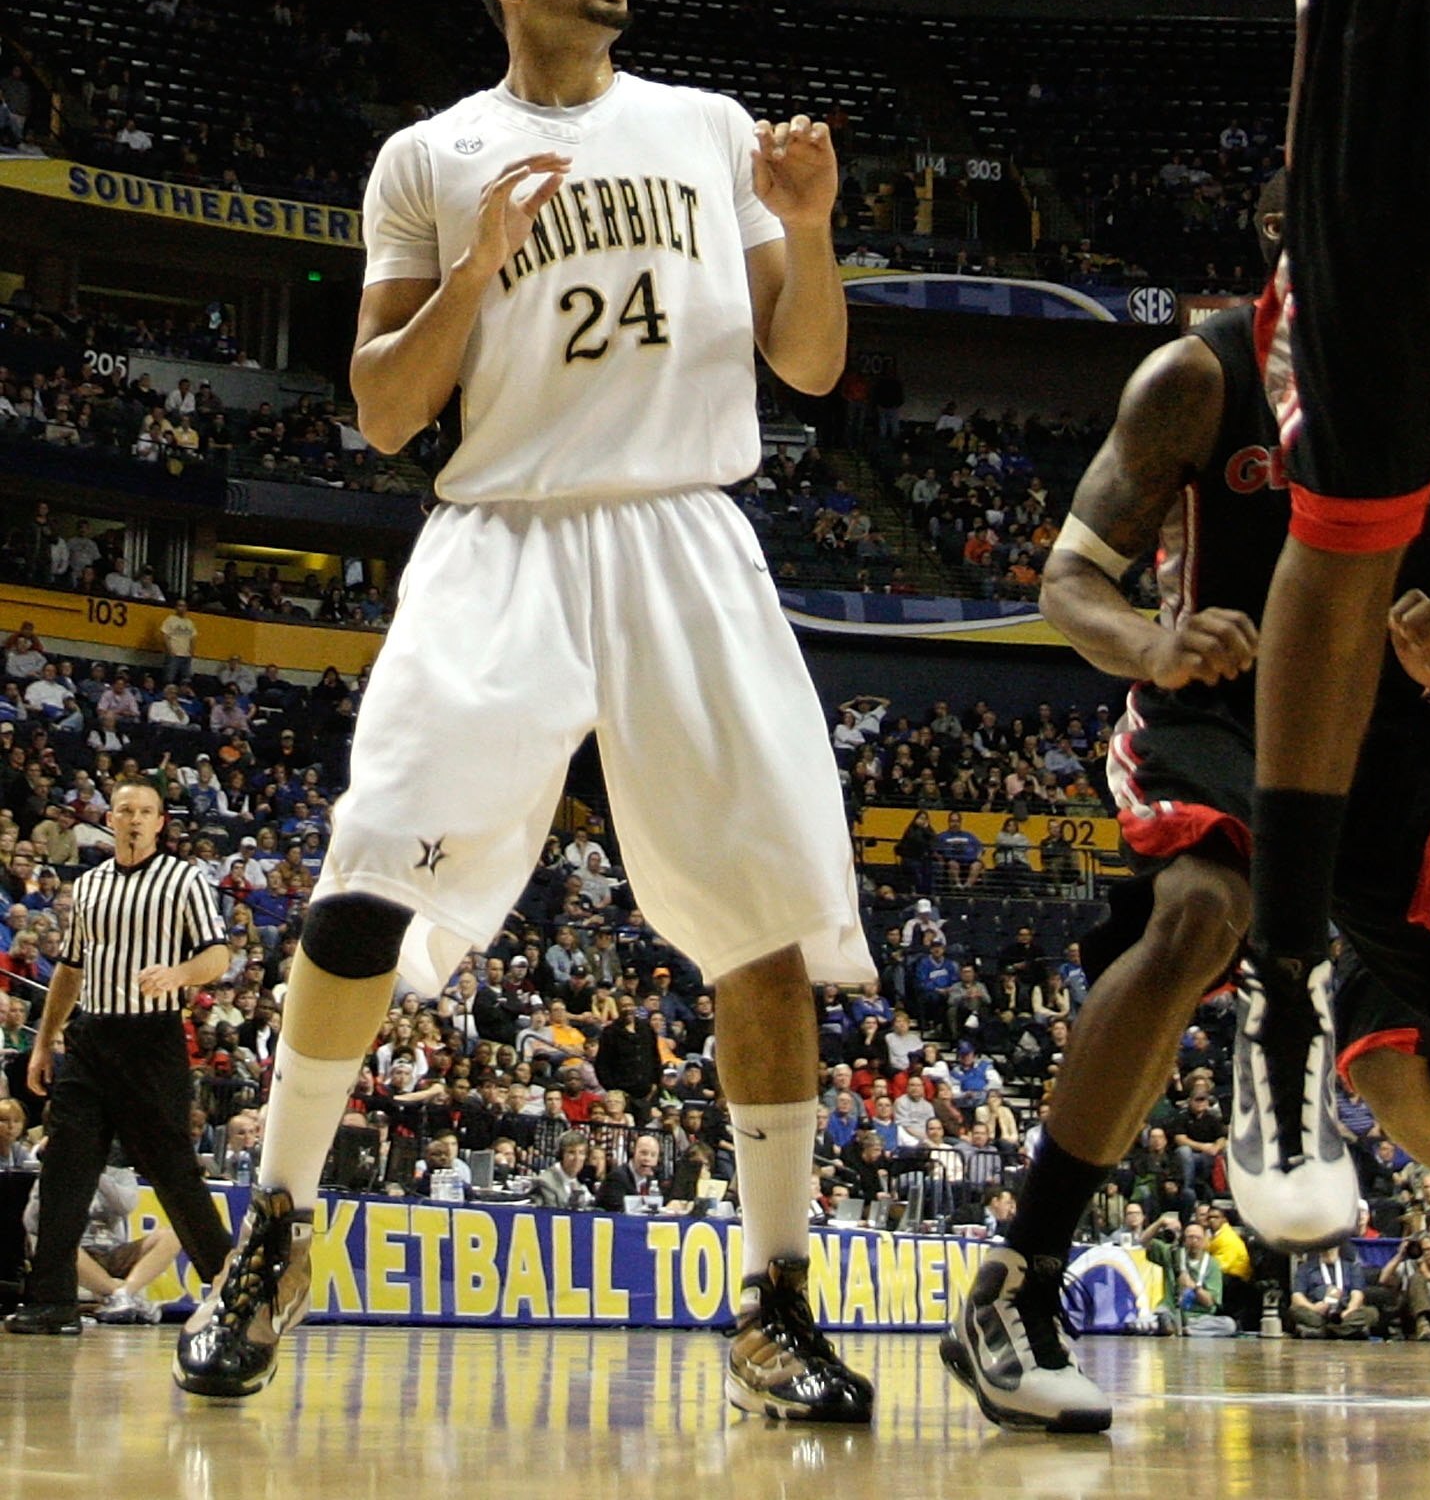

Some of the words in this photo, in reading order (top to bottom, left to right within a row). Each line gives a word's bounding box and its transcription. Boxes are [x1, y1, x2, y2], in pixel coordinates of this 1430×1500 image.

[967, 158, 1002, 181] 303
[68, 165, 364, 243] SOUTHEASTER
[499, 175, 702, 294] NDERBILT
[559, 269, 670, 365] 24
[1132, 286, 1173, 325] SEC
[84, 349, 128, 378] 205
[87, 598, 129, 627] 103
[127, 1185, 630, 1320] BKETBALL
